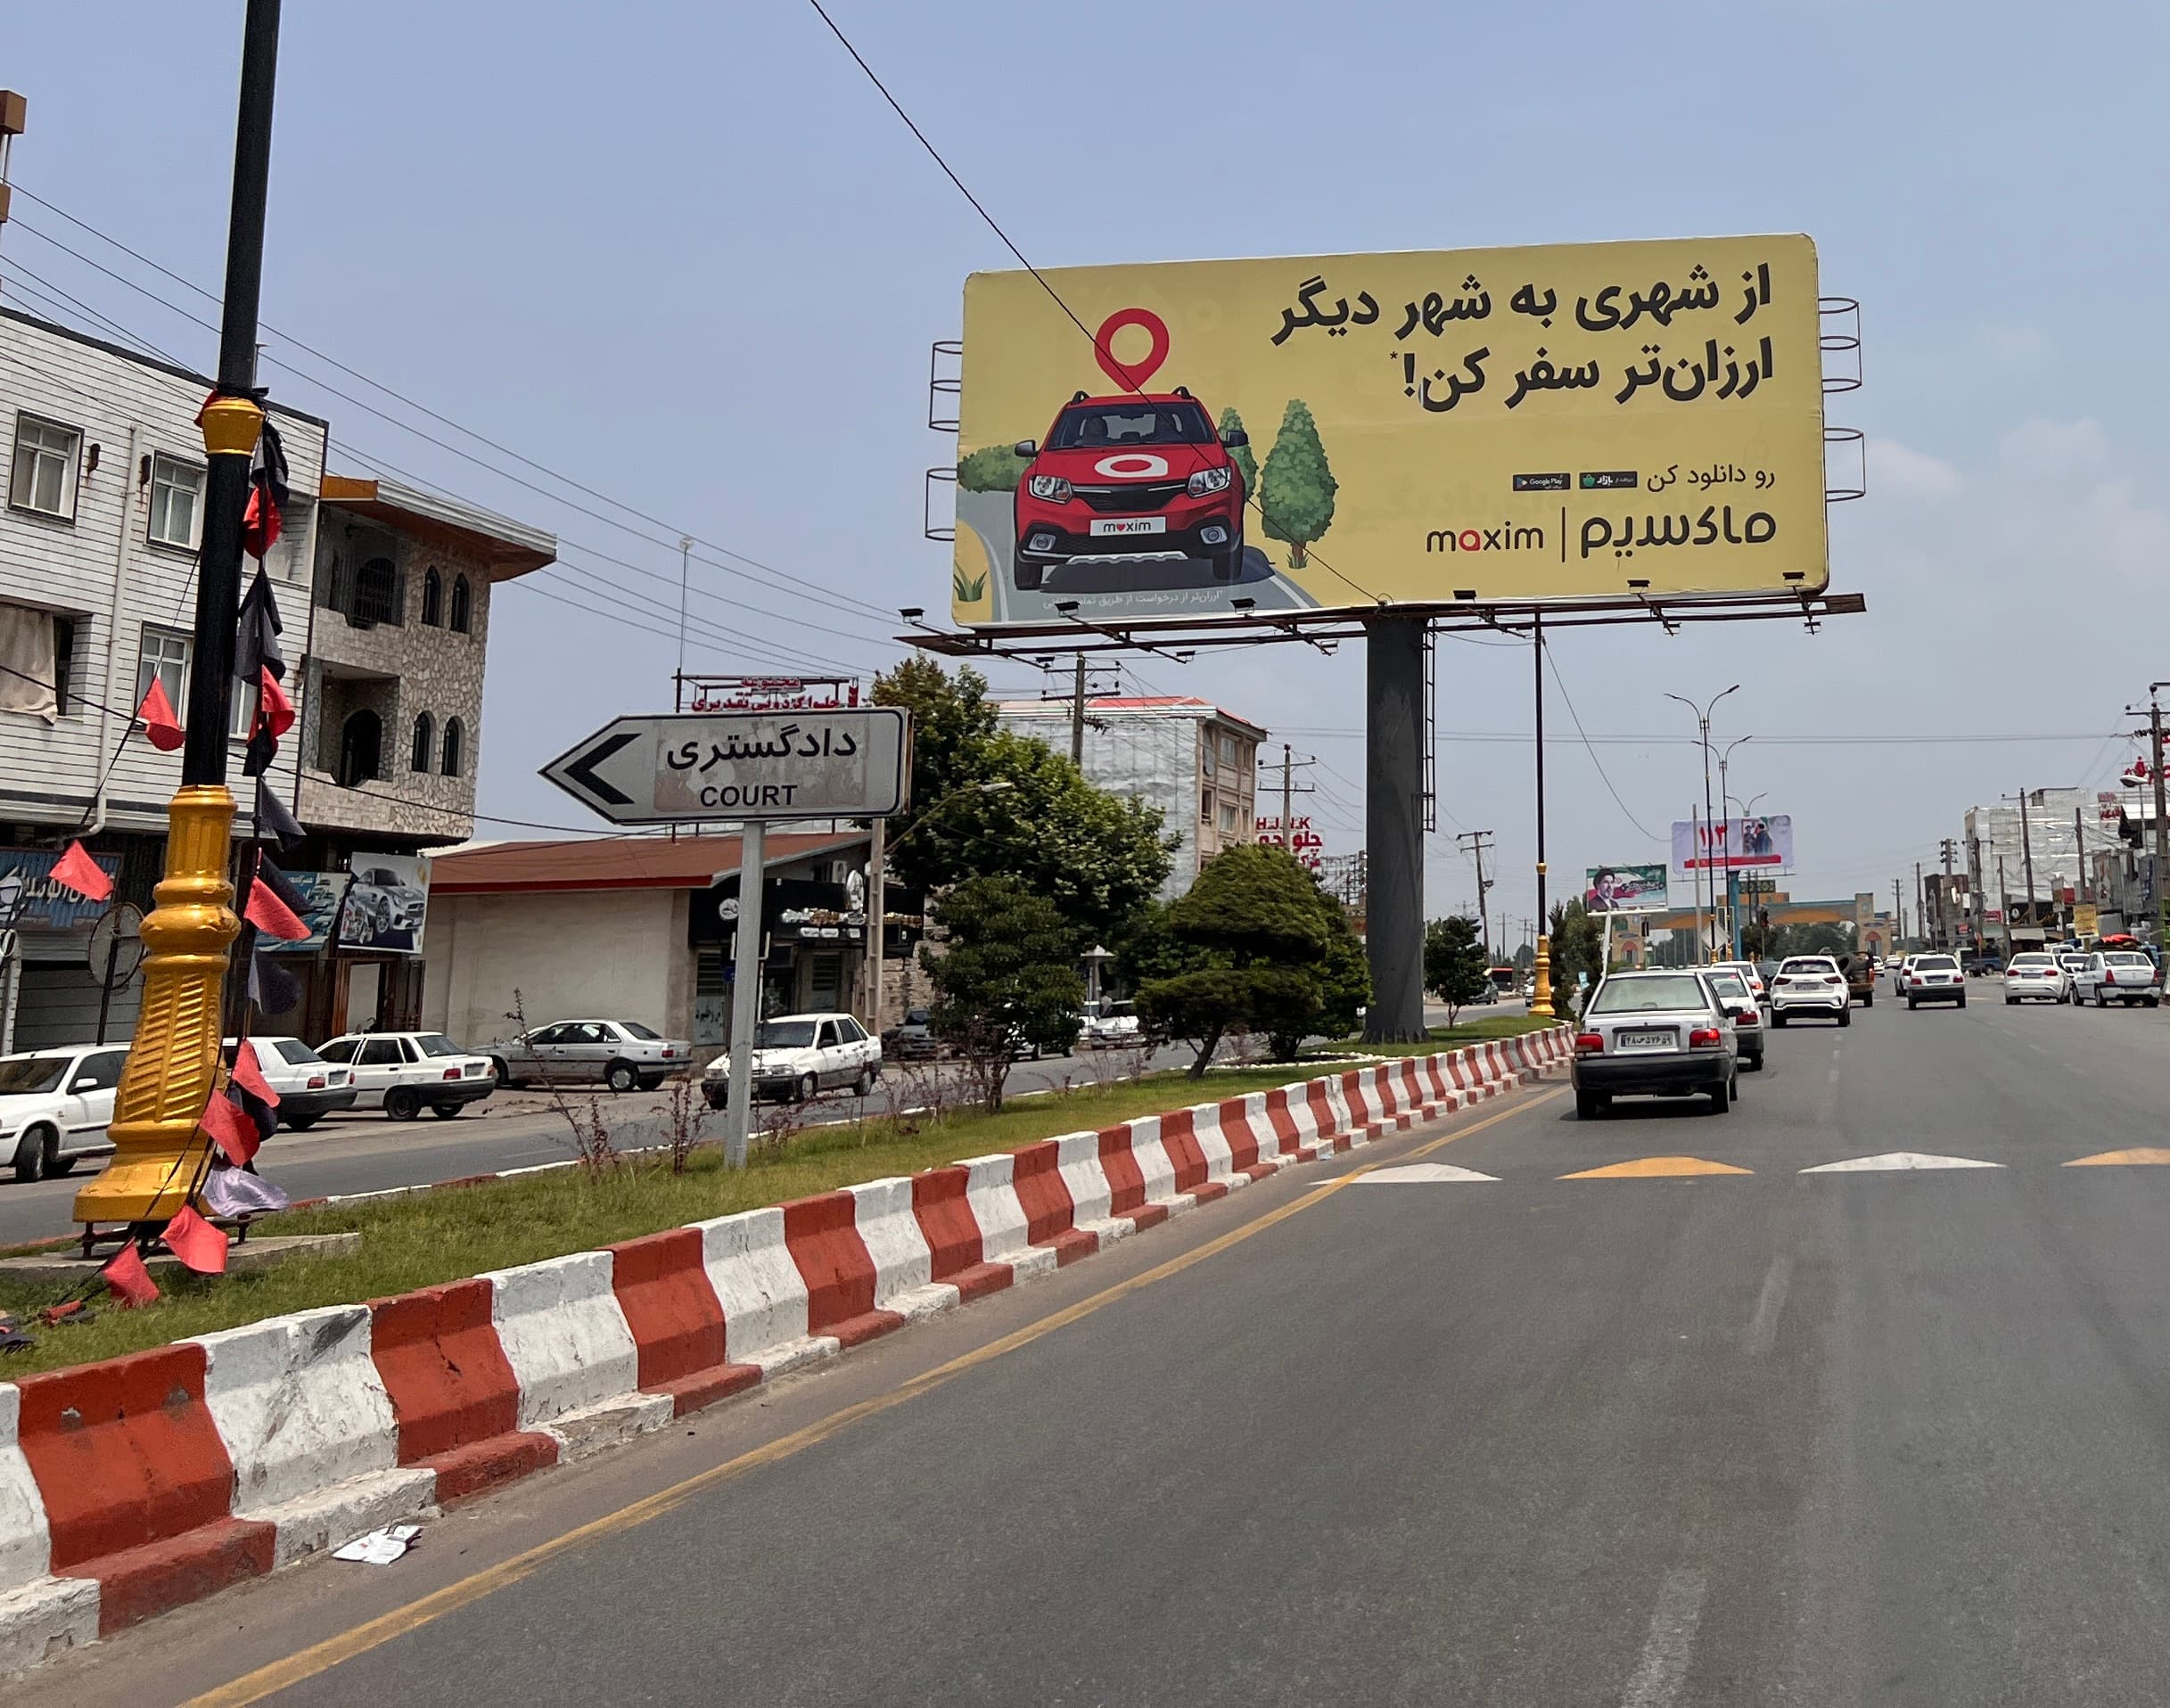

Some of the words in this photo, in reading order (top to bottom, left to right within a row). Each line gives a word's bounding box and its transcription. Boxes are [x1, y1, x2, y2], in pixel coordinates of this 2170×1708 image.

[1270, 275, 1379, 347] دیگر
[1394, 275, 1491, 341] شهر
[1510, 283, 1557, 328] به
[1575, 264, 1719, 331] شهری
[1734, 263, 1770, 324] از
[1505, 347, 1600, 409] سفر
[1529, 477, 1550, 486] Google
[1647, 464, 1679, 492] کن
[1687, 464, 1747, 491] دانلود
[1755, 470, 1775, 489] رو
[1427, 521, 1543, 552] maxim
[1582, 505, 1776, 558] ماکسیم
[667, 723, 858, 773] دادگستری
[699, 784, 798, 808] COURT
